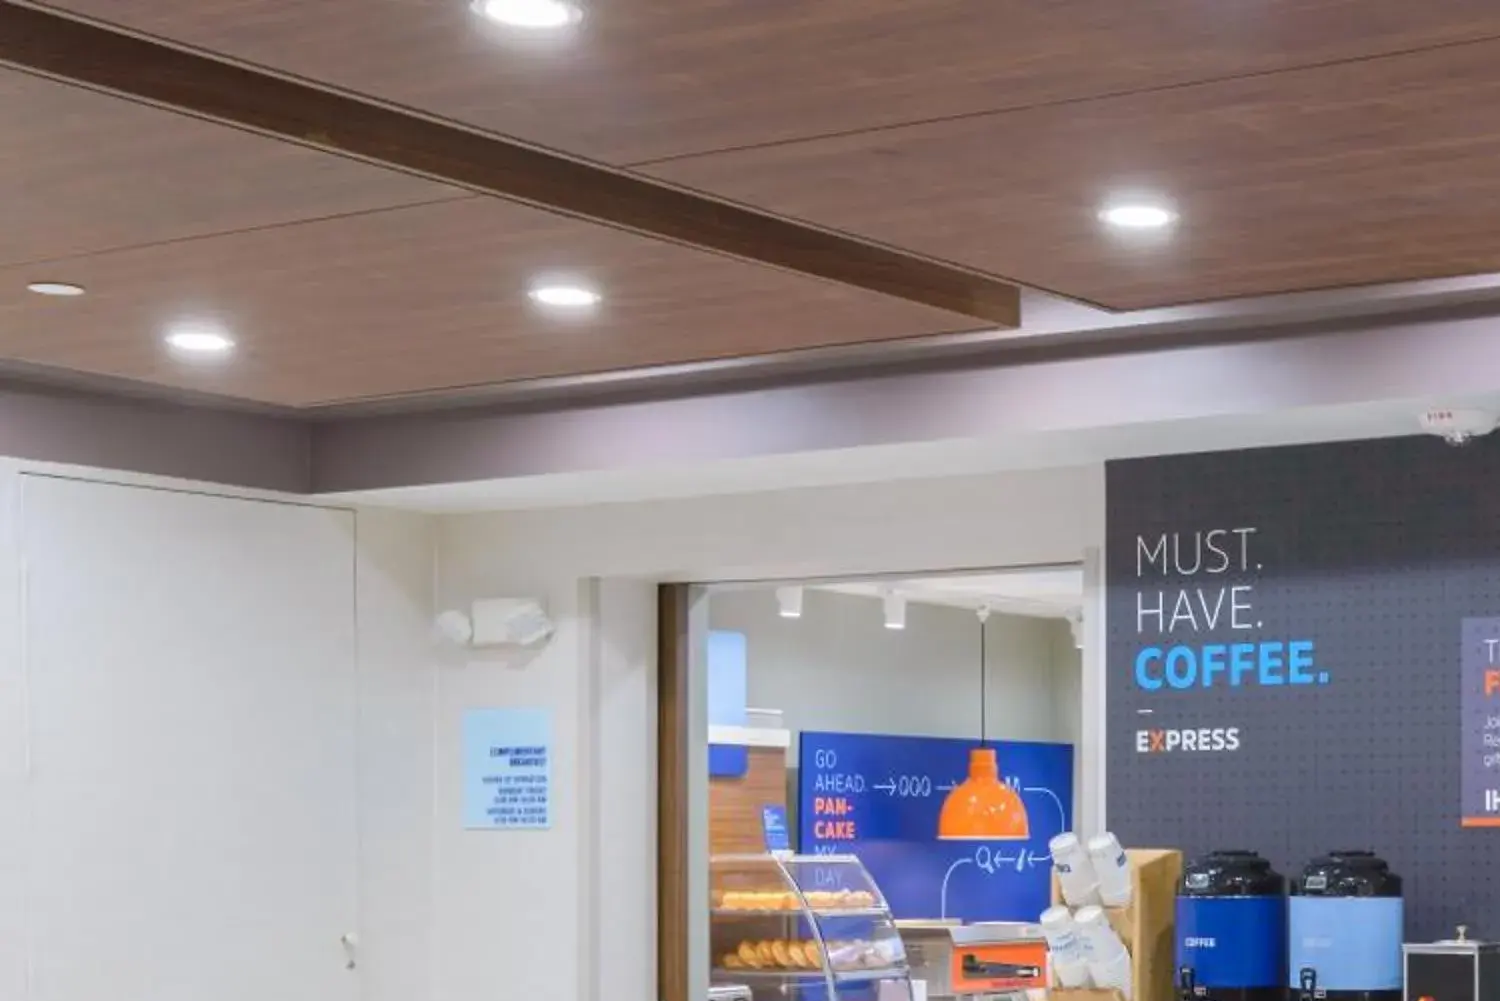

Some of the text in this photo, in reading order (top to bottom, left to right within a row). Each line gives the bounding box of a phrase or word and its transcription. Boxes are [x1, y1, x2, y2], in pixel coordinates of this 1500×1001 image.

[1136, 527, 1263, 577] MUST.
[1136, 585, 1263, 633] HAVE.
[1135, 640, 1331, 689] COFFEE.
[1136, 728, 1240, 752] EXPRESS
[815, 749, 836, 769] GO
[814, 797, 854, 815] PAN-
[814, 820, 855, 839] CAKE
[815, 867, 842, 888] DAY
